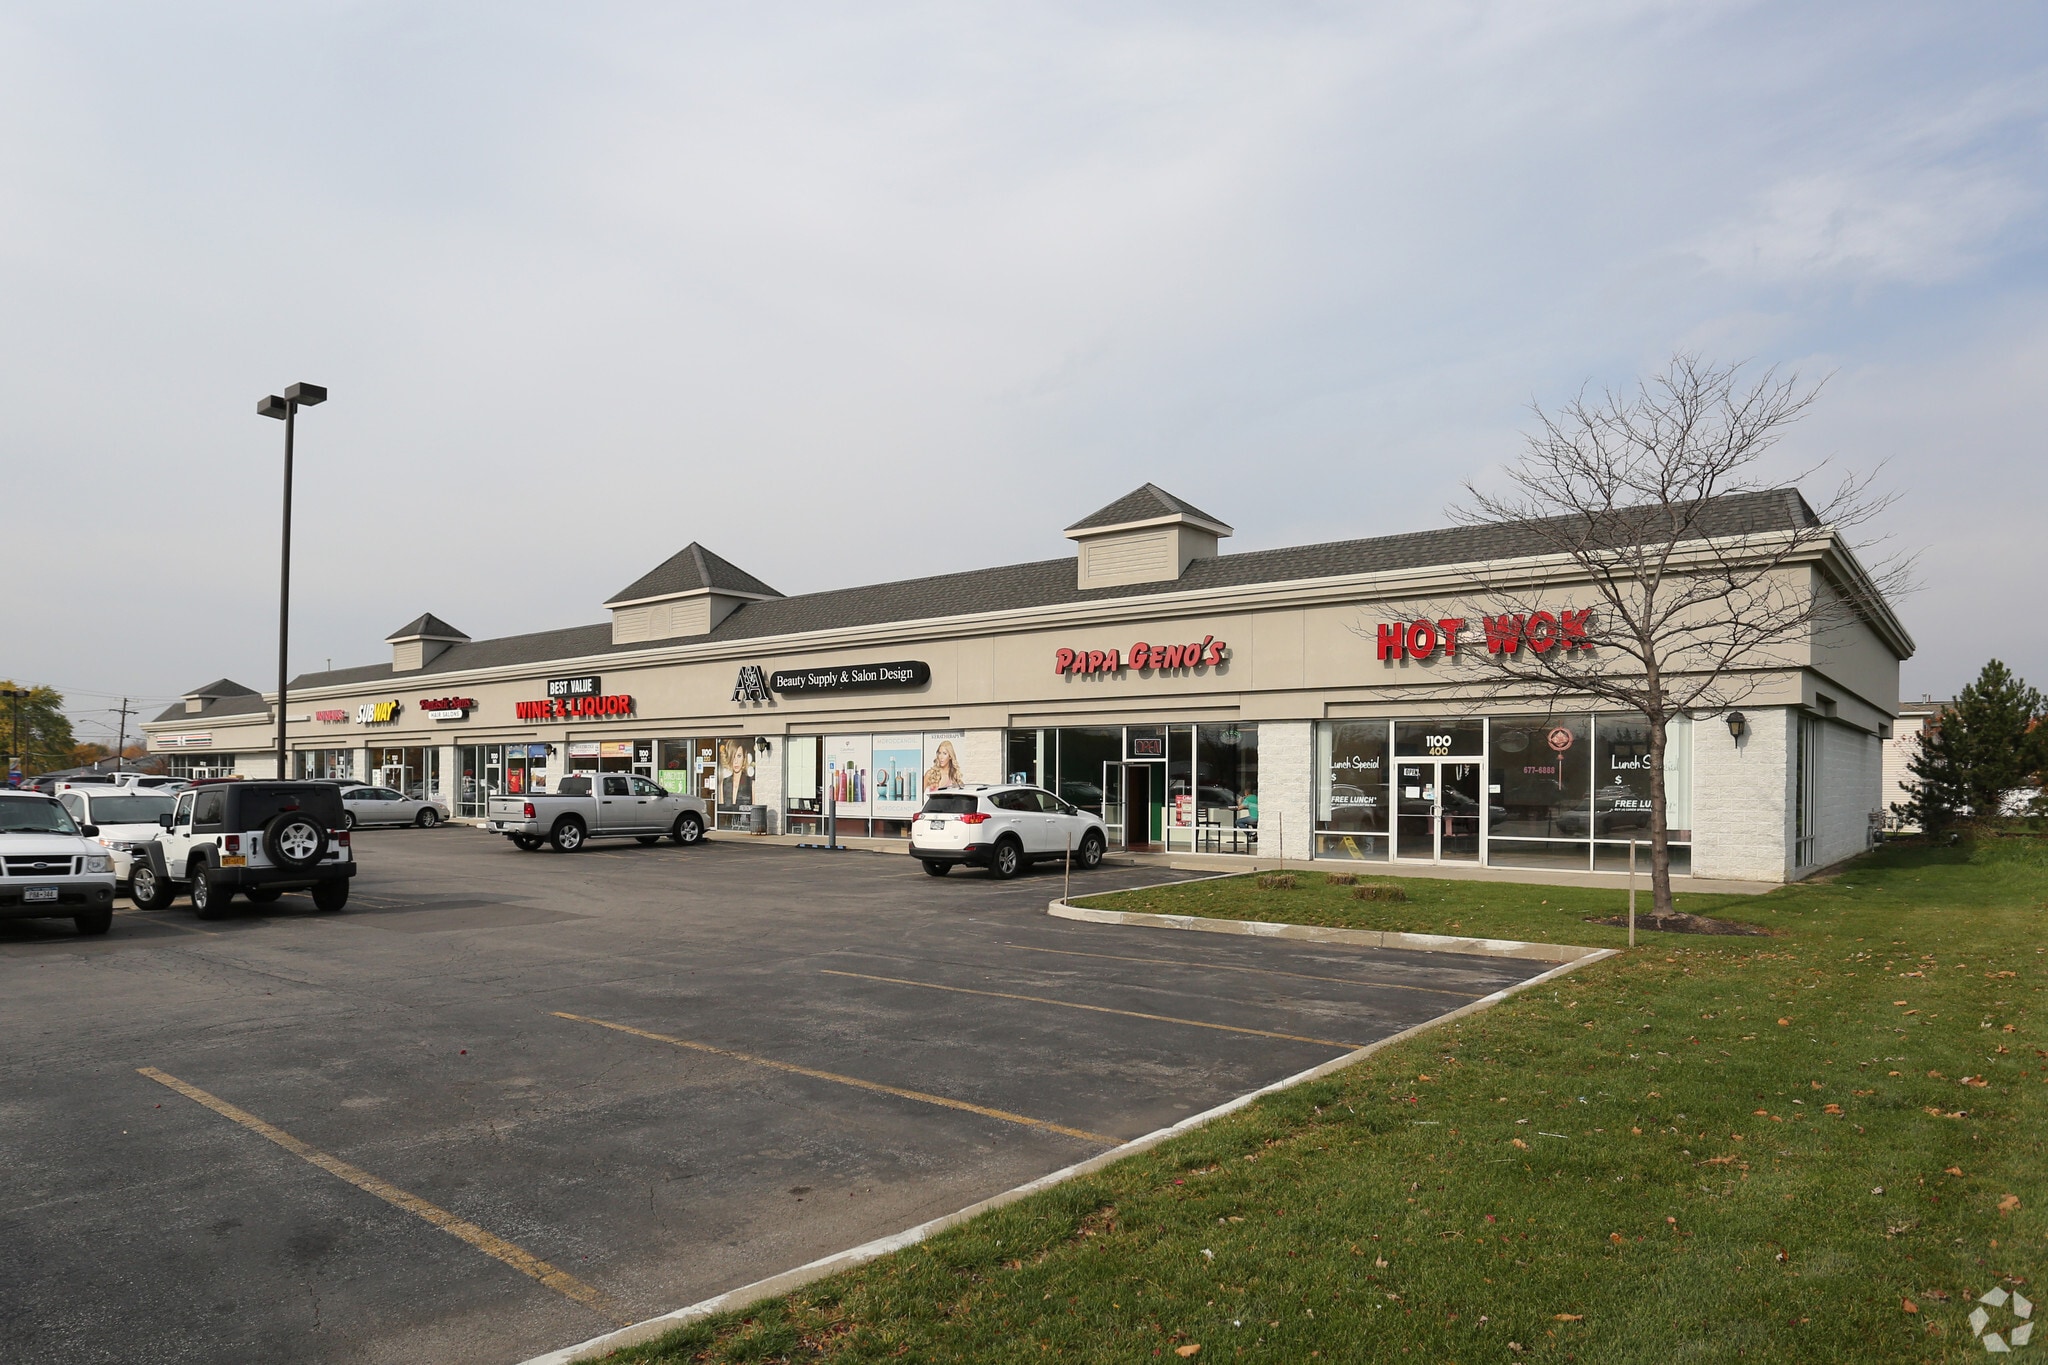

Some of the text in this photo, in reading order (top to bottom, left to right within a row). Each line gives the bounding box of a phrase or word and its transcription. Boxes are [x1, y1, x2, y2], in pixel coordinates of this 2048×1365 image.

[1377, 609, 1593, 660] HOT WOK
[1055, 635, 1227, 674] PAPA GENO'S
[776, 666, 913, 689] Beauty Supply & Salon Design
[549, 679, 593, 695] BEST VALUE
[356, 699, 399, 723] SUBWAY
[515, 695, 631, 719] WINE & LIQUOR
[1426, 735, 1451, 747] 1100
[1429, 747, 1448, 755] 400
[1329, 755, 1379, 772] Lunch Special
[1611, 754, 1640, 769] Lunch
[1615, 775, 1622, 785] $
